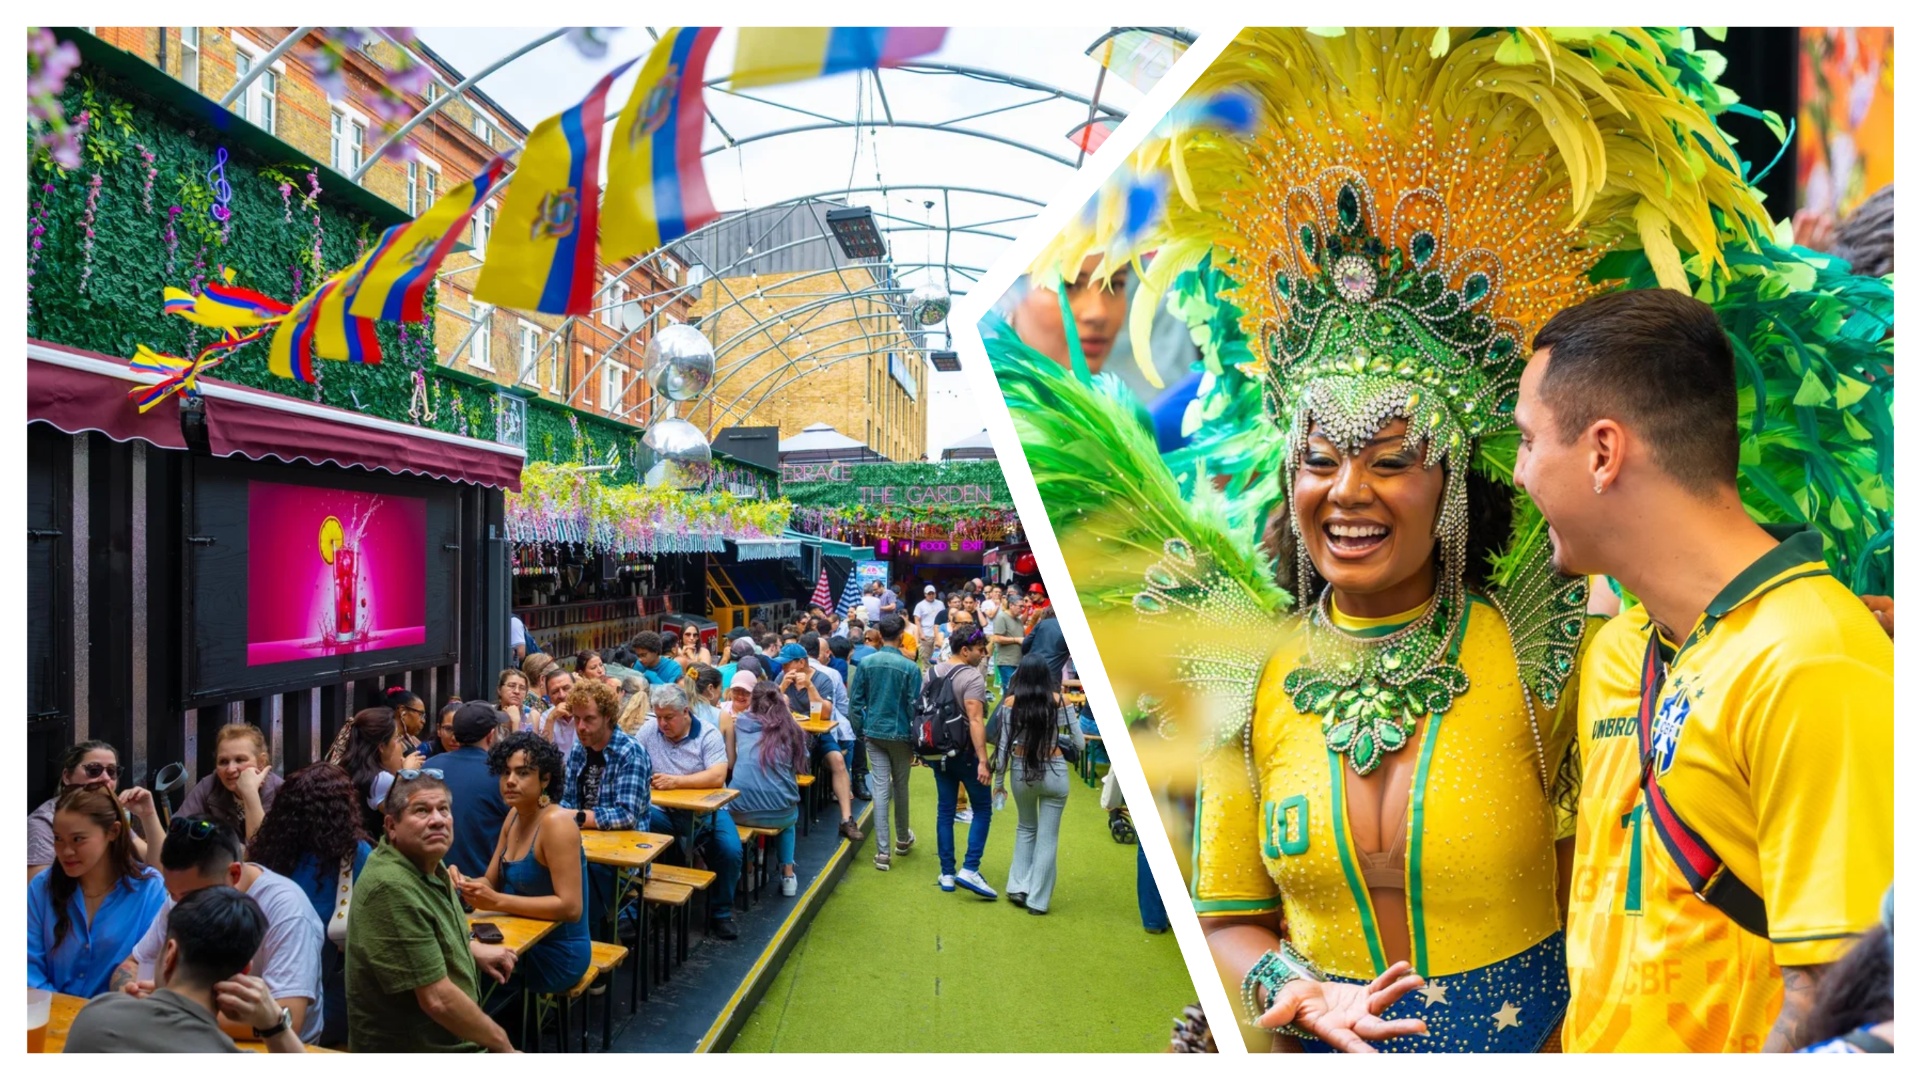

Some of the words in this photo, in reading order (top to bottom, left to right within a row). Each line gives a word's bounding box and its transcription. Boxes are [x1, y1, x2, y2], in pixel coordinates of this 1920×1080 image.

[858, 485, 896, 504] THE
[906, 484, 992, 504] GARDEN
[920, 541, 947, 551] FOOD
[961, 541, 983, 551] EXIT
[1264, 794, 1310, 860] 10
[1623, 959, 1682, 995] CBF
